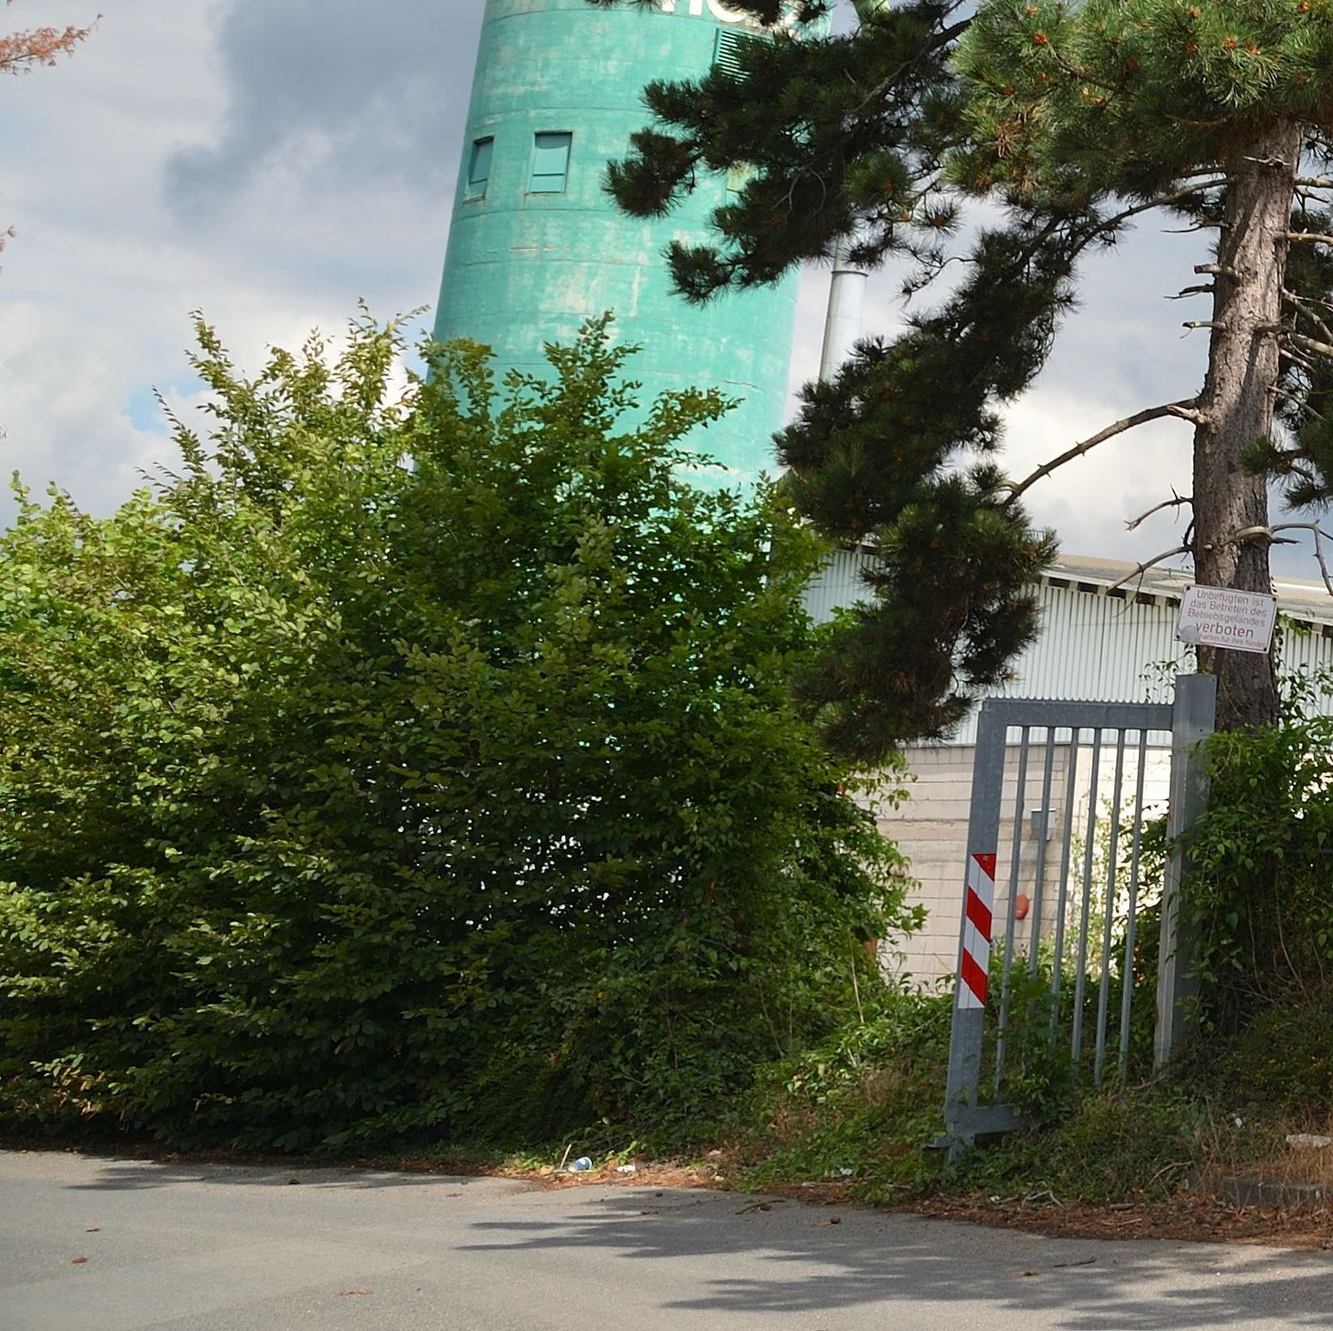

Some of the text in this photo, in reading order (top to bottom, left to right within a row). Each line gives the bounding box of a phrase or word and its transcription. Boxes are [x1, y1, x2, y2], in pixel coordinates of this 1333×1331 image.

[1196, 589, 1265, 607] Unbefugten ist
[1190, 599, 1267, 618] das Betreten des
[1196, 622, 1255, 639] verboten
